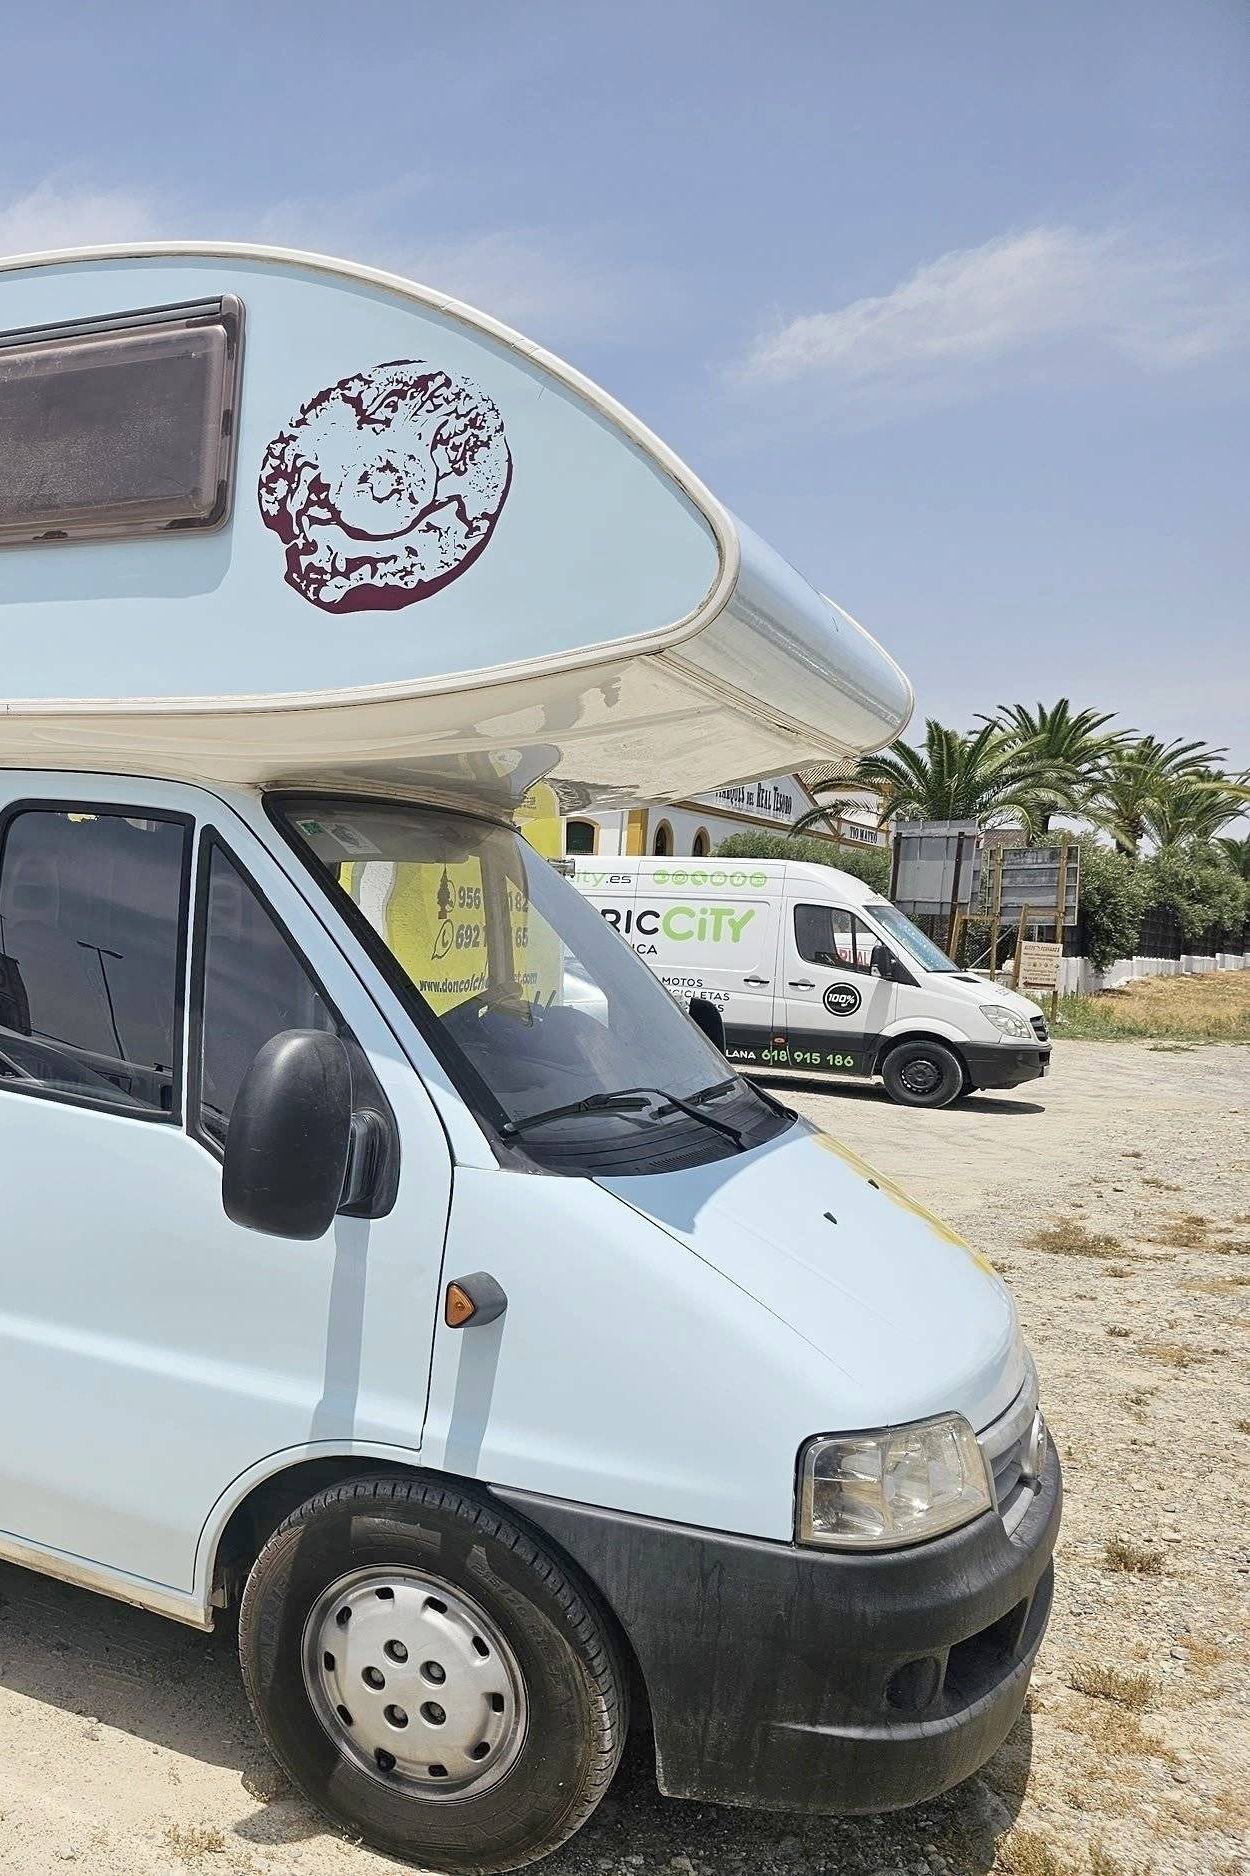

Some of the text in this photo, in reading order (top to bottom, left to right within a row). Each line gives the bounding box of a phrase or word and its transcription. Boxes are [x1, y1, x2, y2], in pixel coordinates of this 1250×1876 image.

[458, 886, 481, 910] 956
[456, 924, 480, 949] 692
[661, 976, 703, 988] MOTOS
[828, 993, 855, 1005] 100%
[725, 1049, 854, 1067] LANA 618 915 186
